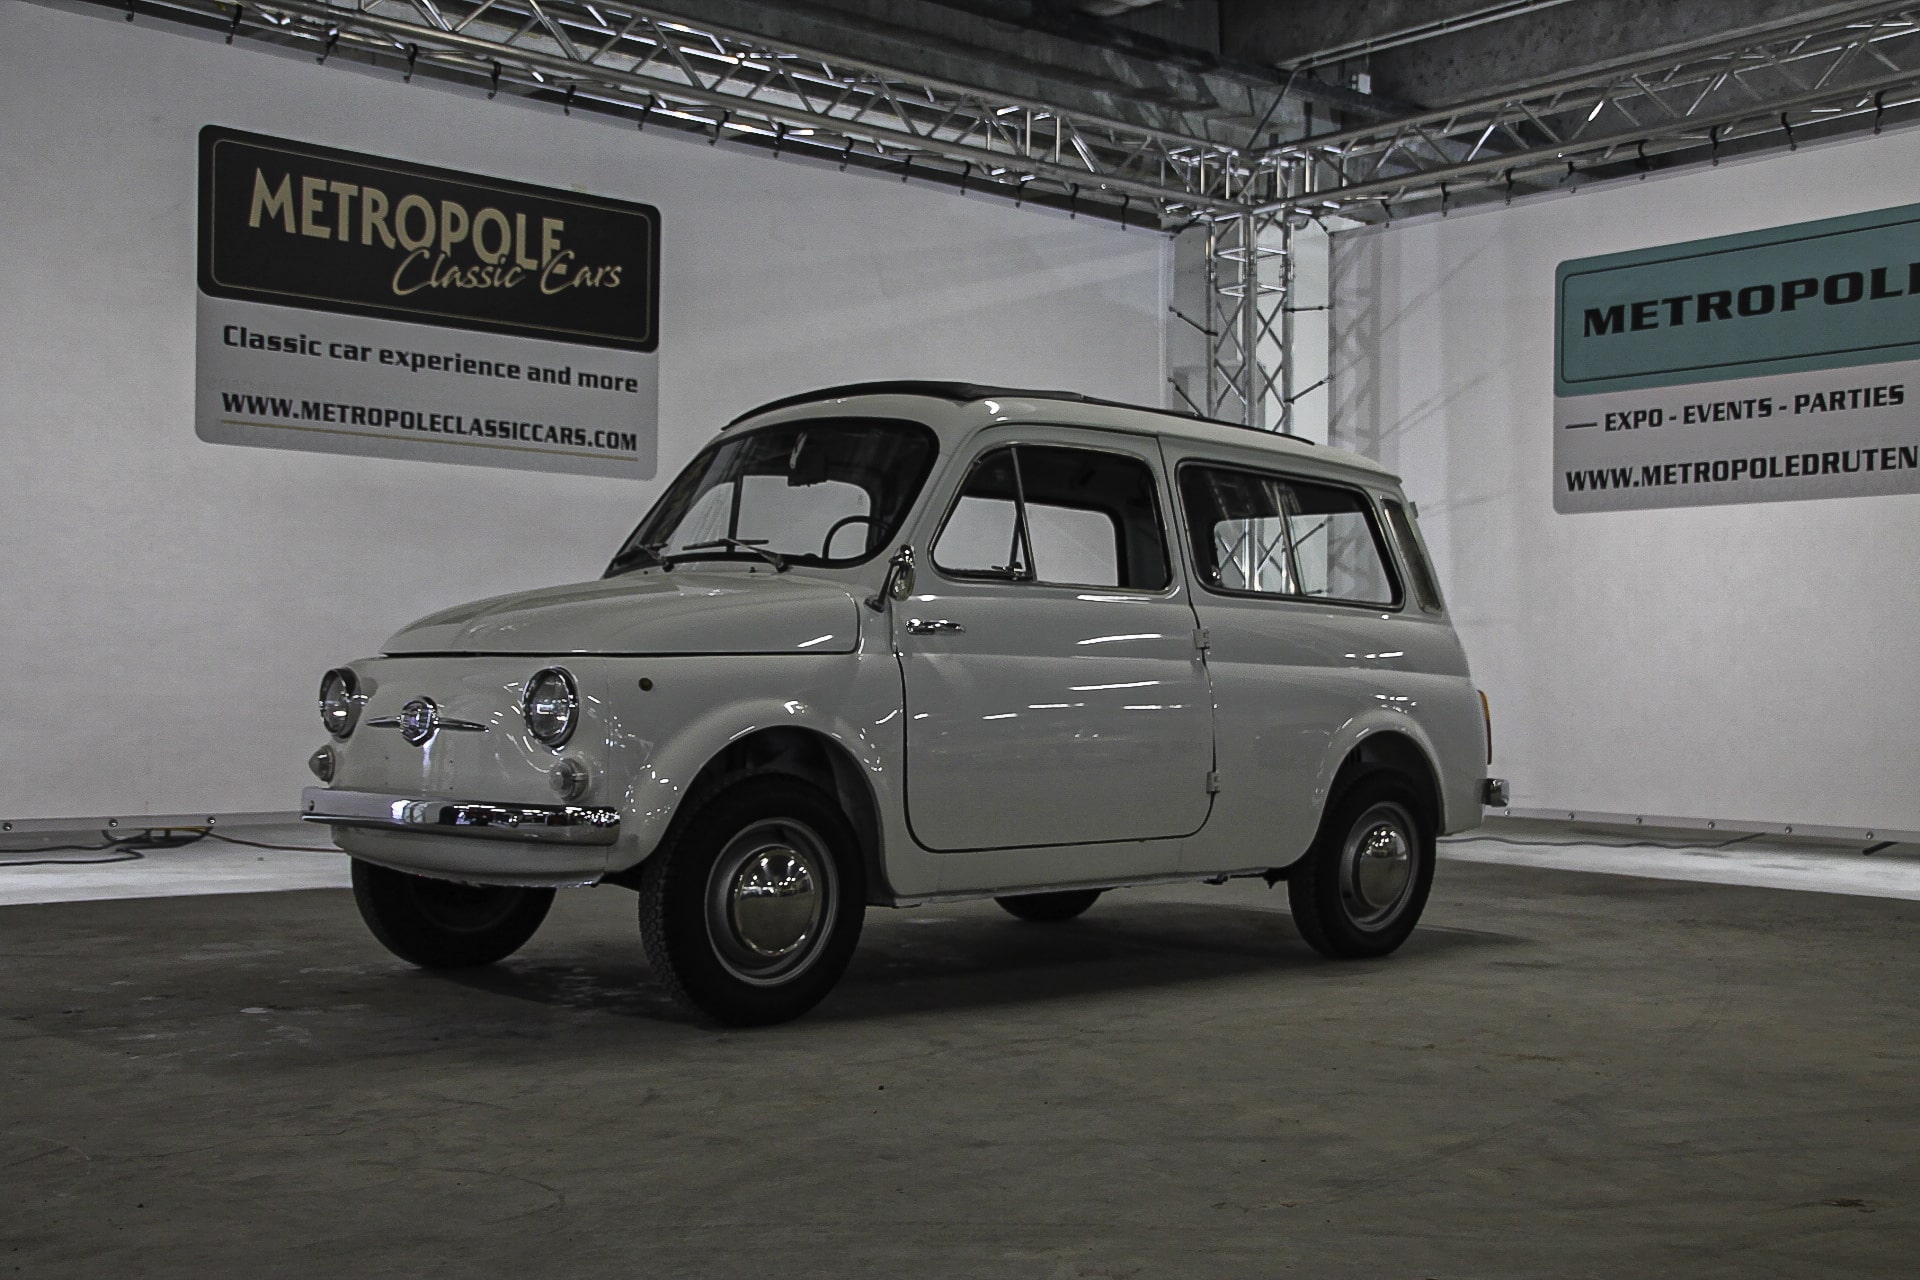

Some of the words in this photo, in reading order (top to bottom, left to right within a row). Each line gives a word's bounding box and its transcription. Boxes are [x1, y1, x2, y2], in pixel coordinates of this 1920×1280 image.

[248, 167, 568, 275] METROPOLE
[392, 248, 527, 296] Classic
[539, 250, 622, 295] Cars
[222, 324, 322, 357] Classic
[329, 341, 371, 363] car
[379, 348, 521, 380] experience
[526, 364, 571, 387] and
[577, 372, 638, 394] more
[221, 392, 638, 452] WWW.METROPOLECLASSICCARS.COM
[1605, 408, 1663, 432] EXPO
[1683, 398, 1773, 425] EVENTS
[1794, 384, 1905, 415] PARTIES
[1566, 446, 1919, 492] WWW.METROPOLEDRUTEN
